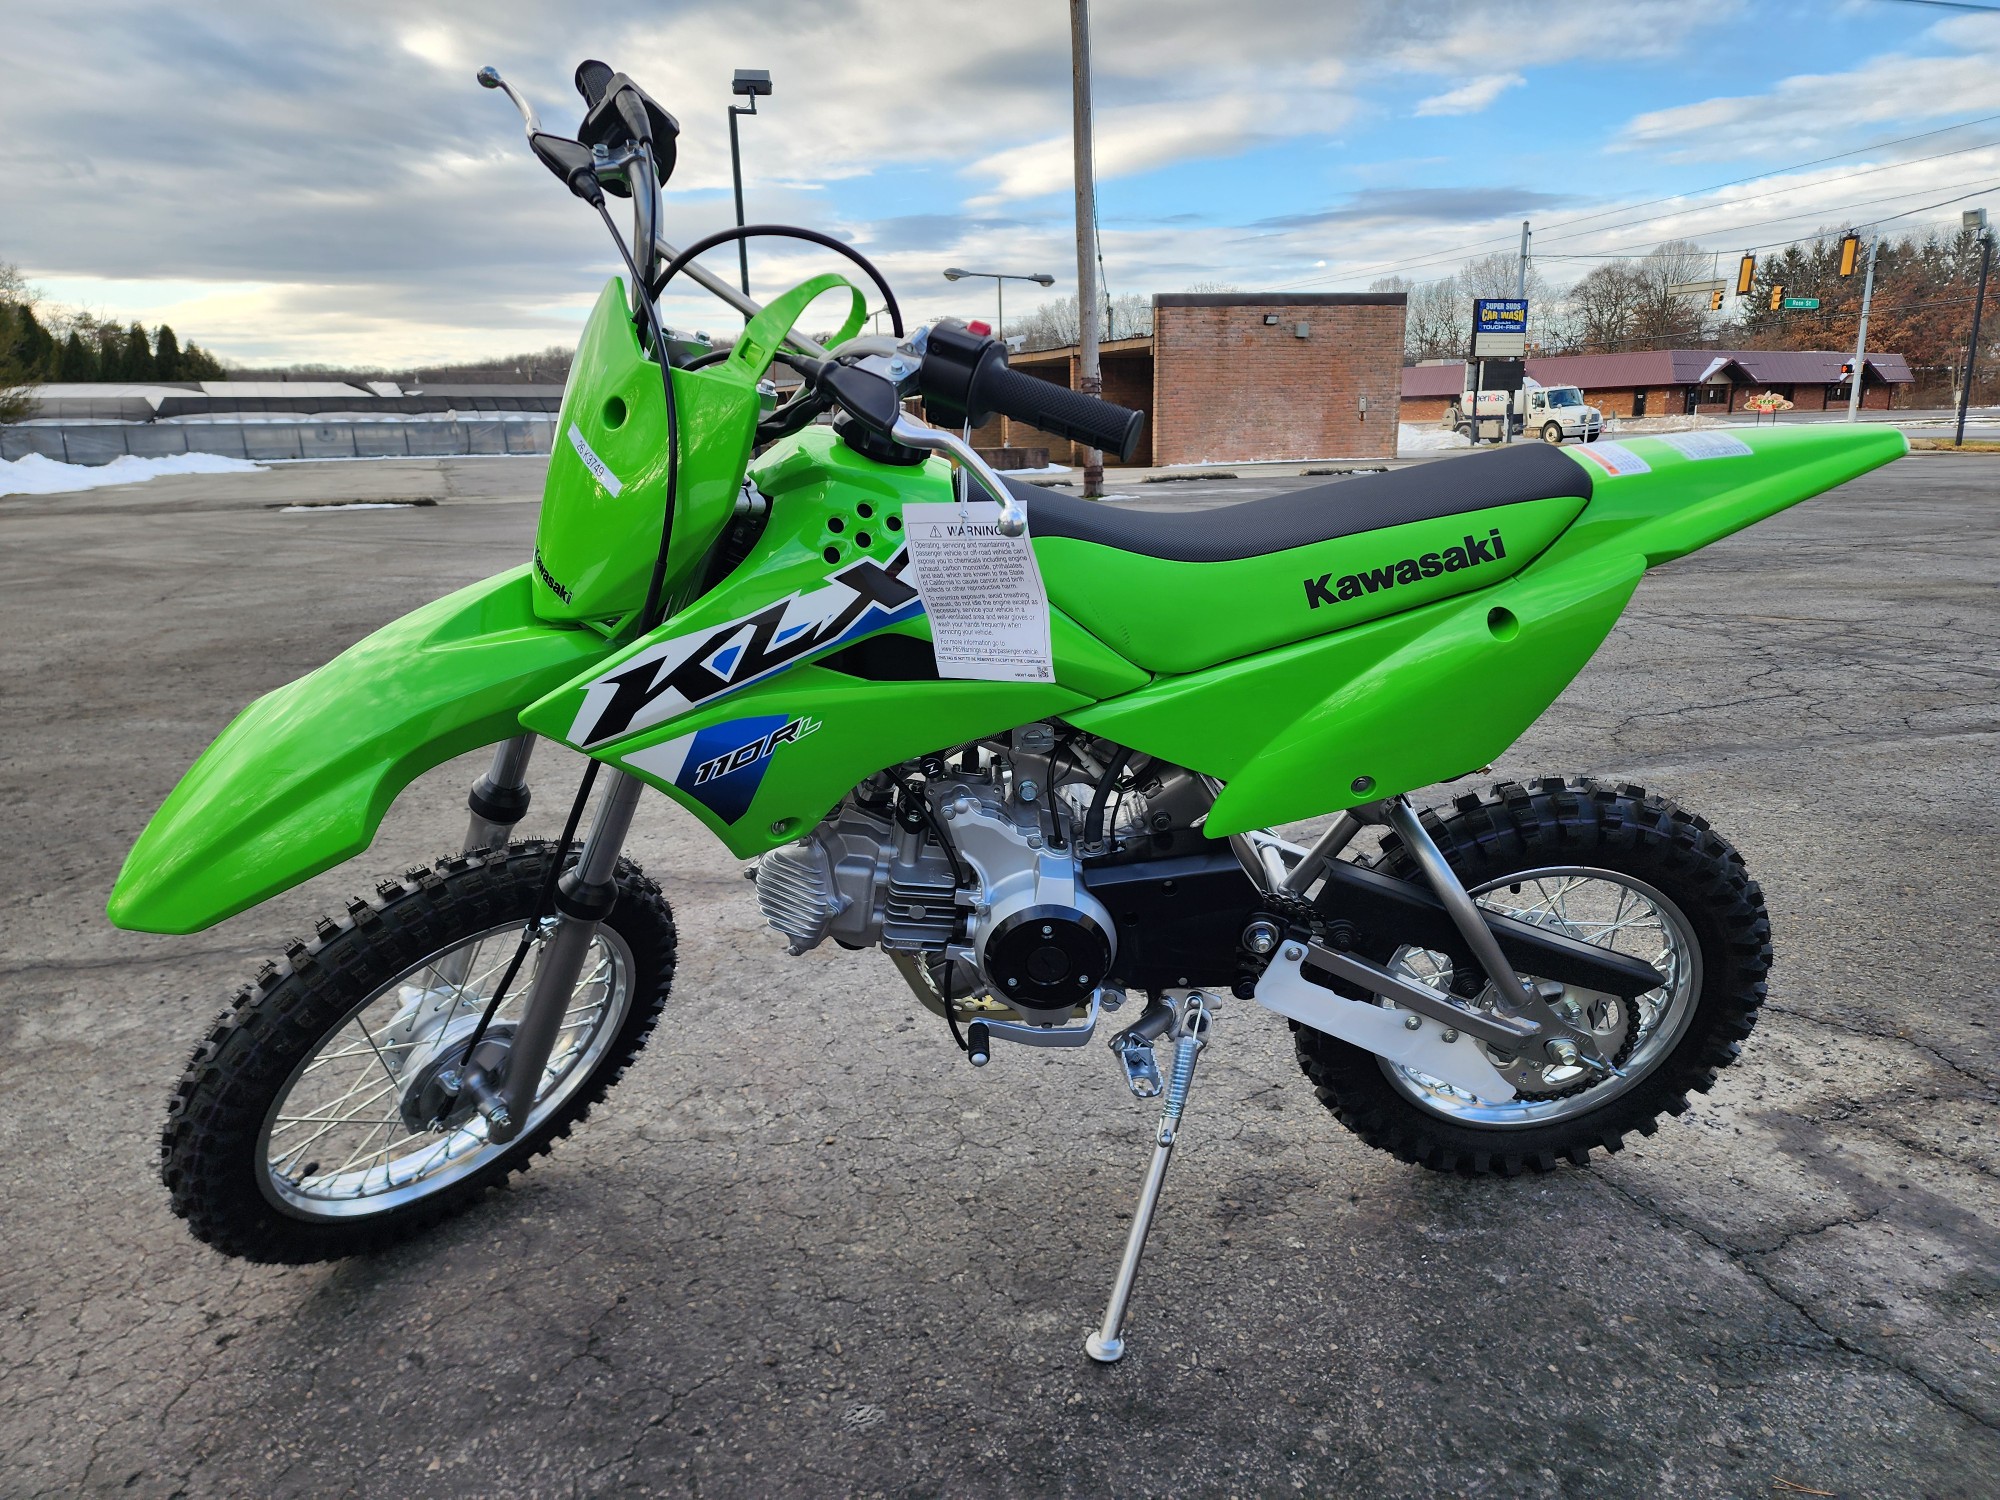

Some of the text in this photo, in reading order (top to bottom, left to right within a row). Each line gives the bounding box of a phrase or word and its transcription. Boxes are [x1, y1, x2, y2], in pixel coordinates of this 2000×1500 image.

[1485, 302, 1521, 310] SUPER SUDS
[1481, 308, 1525, 322] CAR WASH
[582, 451, 605, 477] K3749
[946, 525, 1003, 537] WARNING
[1303, 528, 1507, 610] Kawasaki
